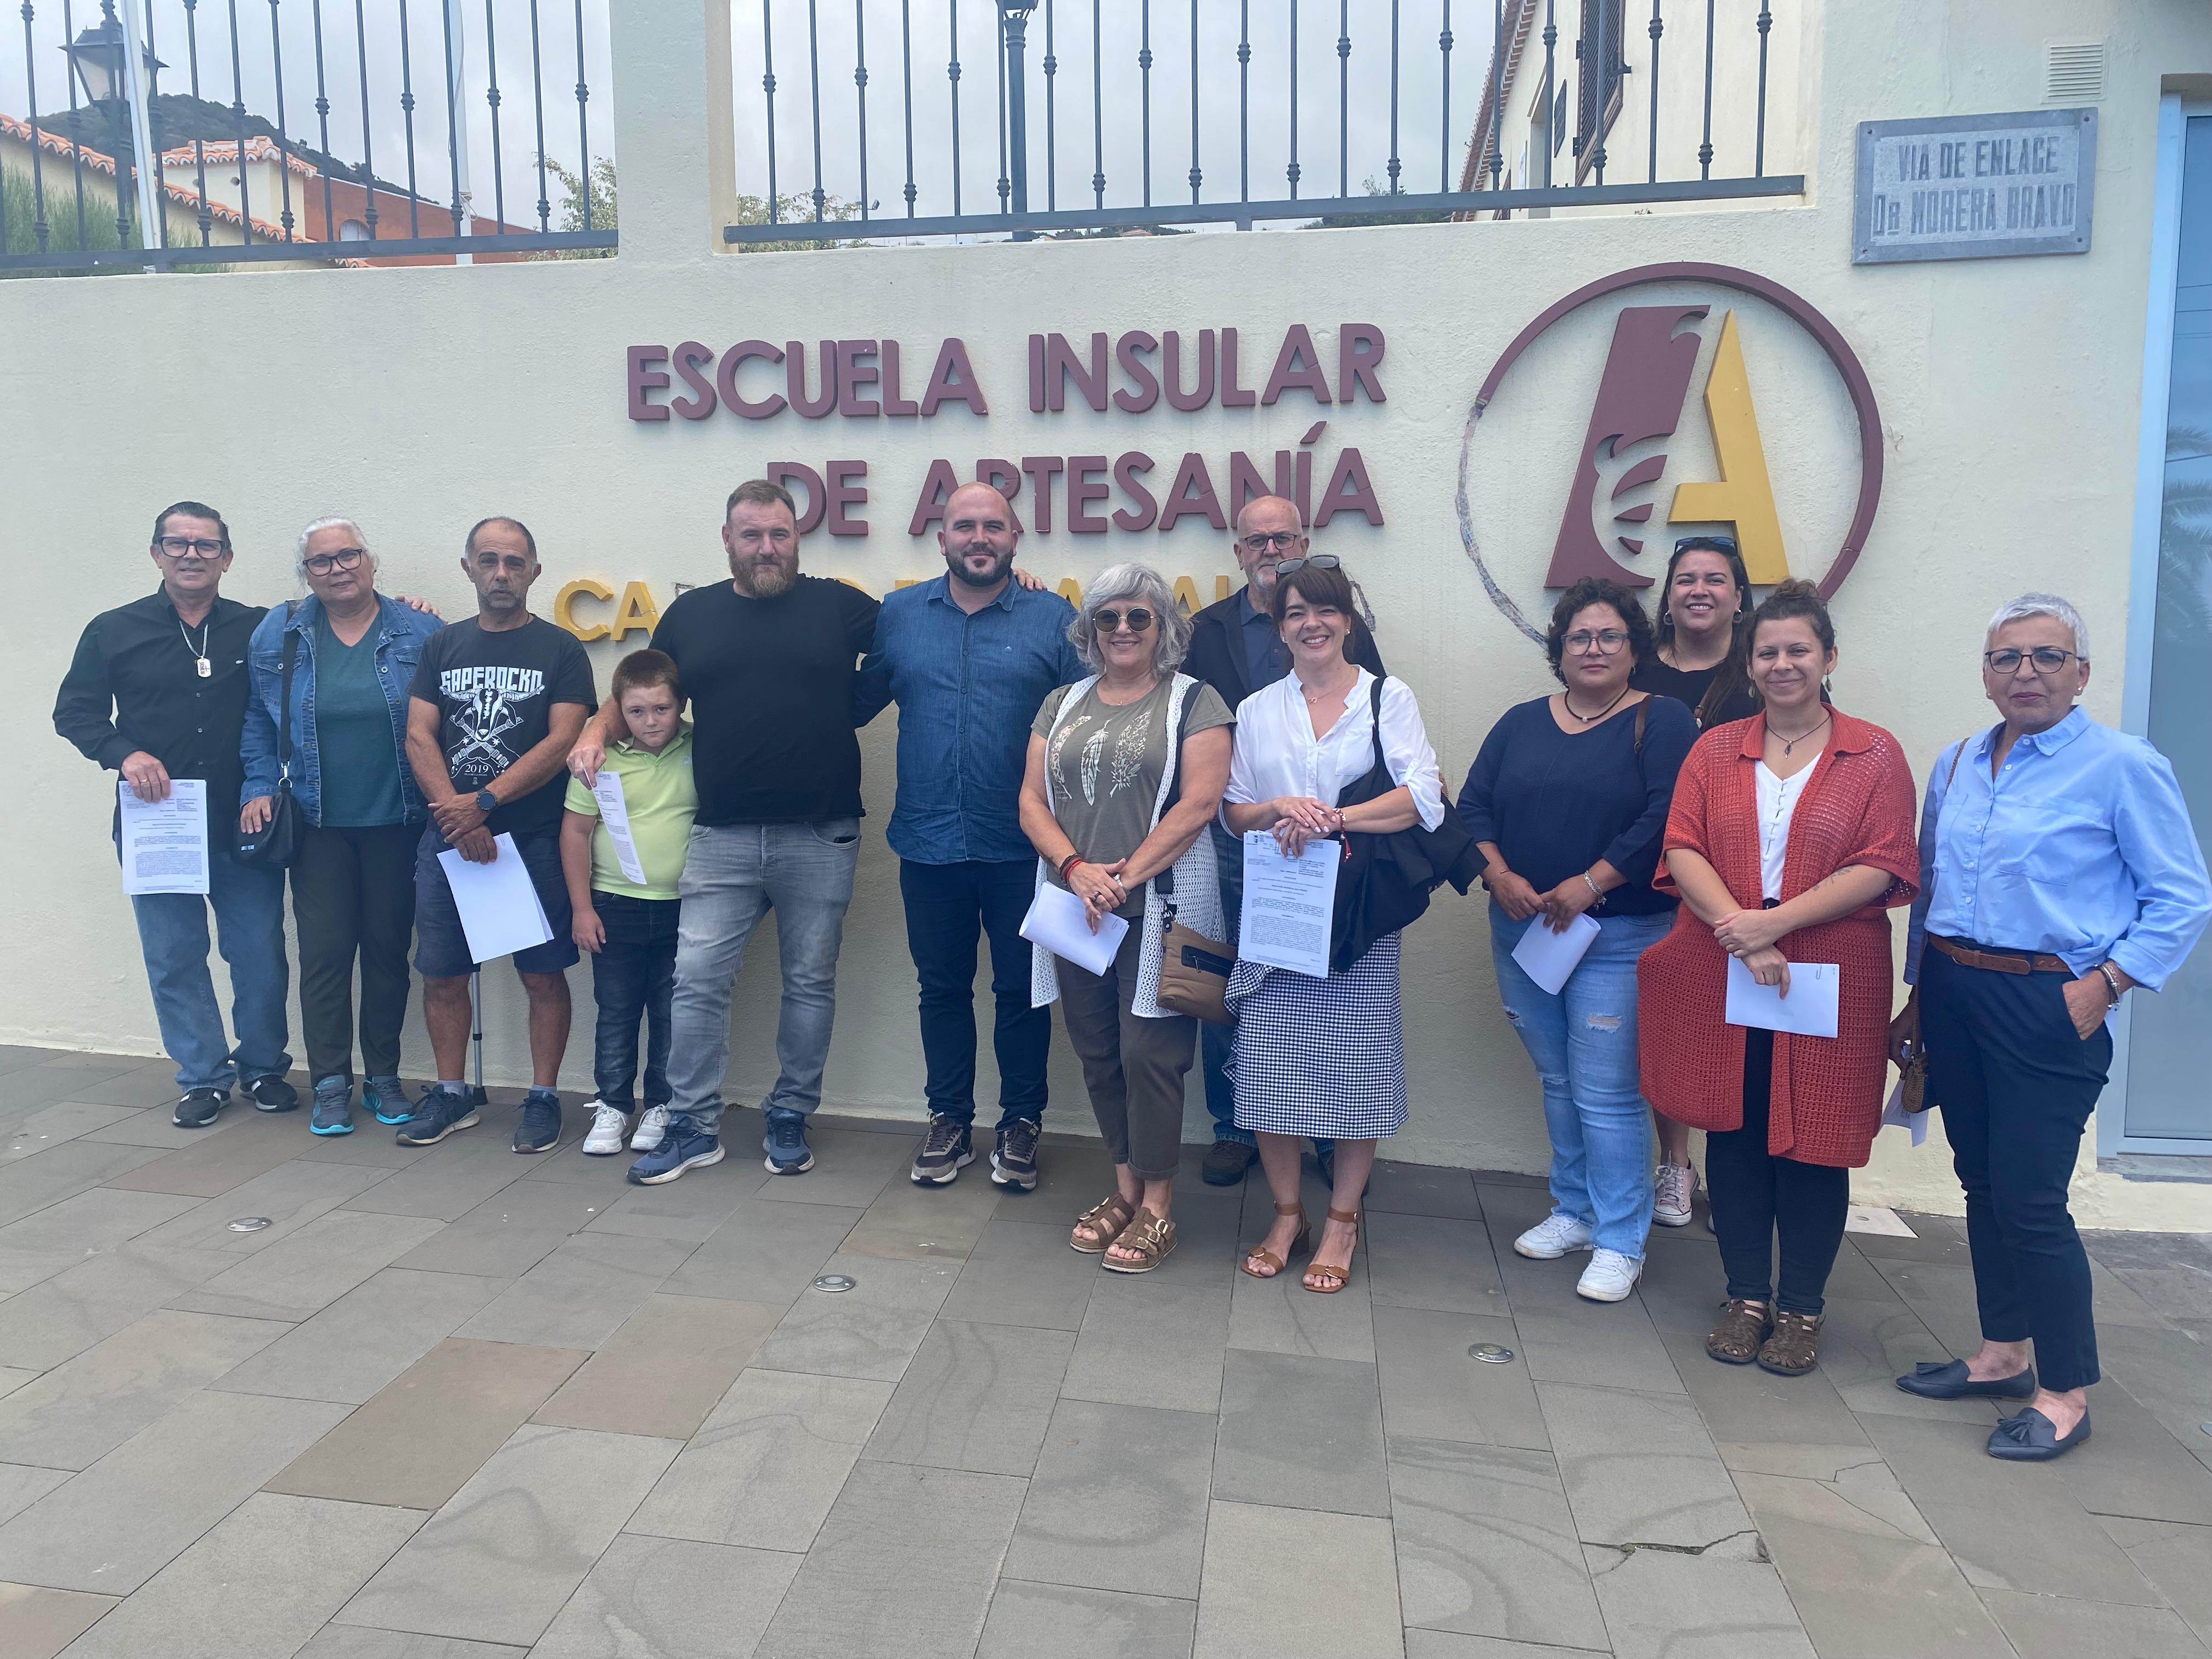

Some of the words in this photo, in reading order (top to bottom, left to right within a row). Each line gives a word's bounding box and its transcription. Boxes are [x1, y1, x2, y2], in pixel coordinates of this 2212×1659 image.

[1898, 143, 1929, 181] VIA
[1939, 142, 1966, 179] DE
[1975, 136, 2060, 177] ENLACE
[2006, 183, 2075, 229] BRAVO
[627, 337, 989, 420] ESCUELA
[1028, 323, 1387, 412] INSULAR
[767, 460, 868, 535] DE
[465, 764, 489, 773] 2019
